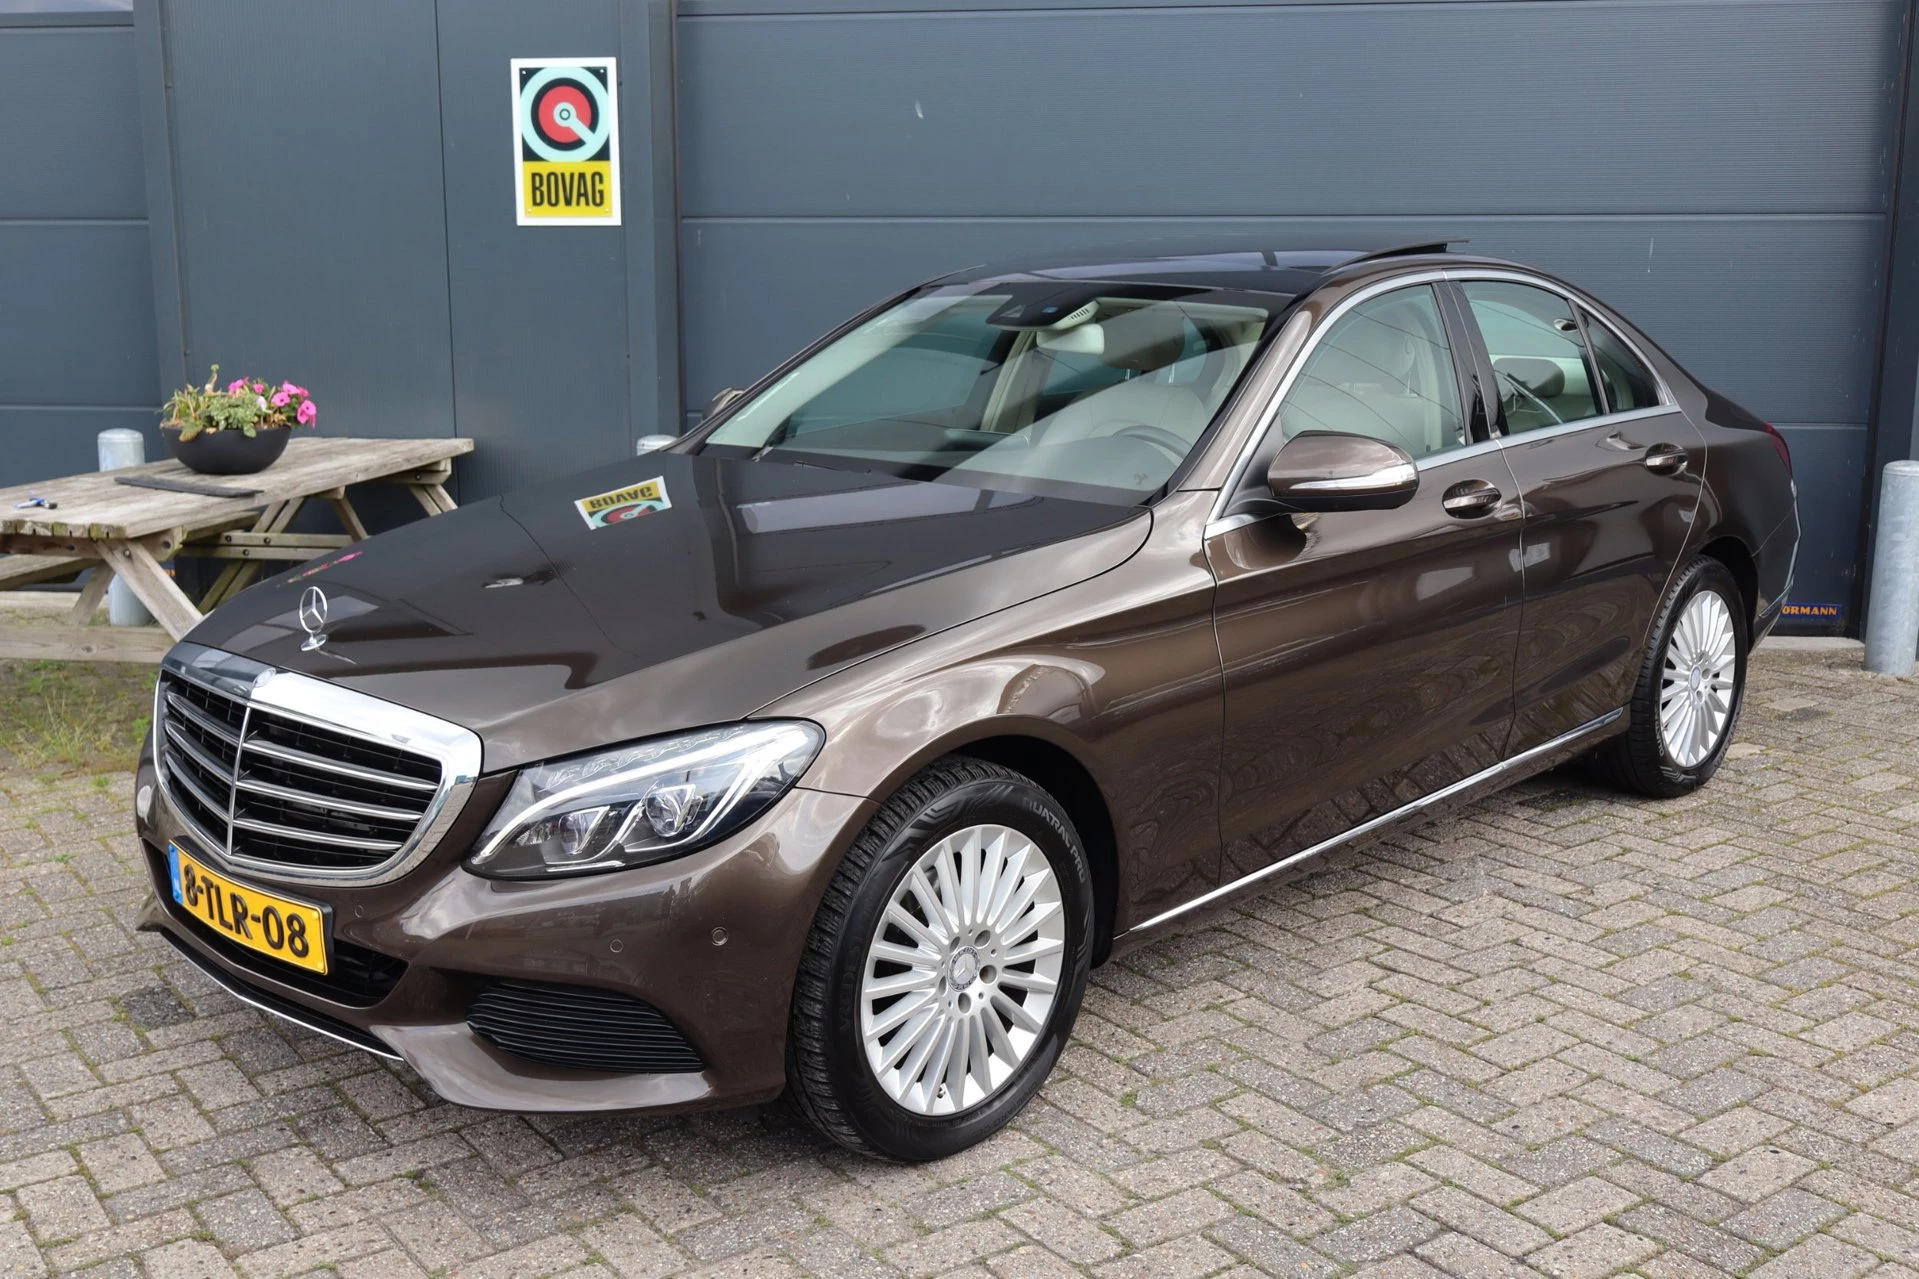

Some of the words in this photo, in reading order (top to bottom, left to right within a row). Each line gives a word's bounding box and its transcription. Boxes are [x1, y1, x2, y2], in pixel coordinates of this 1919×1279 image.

[531, 172, 604, 207] BOVAG
[1070, 844, 1086, 885] PRO
[184, 864, 309, 958] 8-TLR-08
